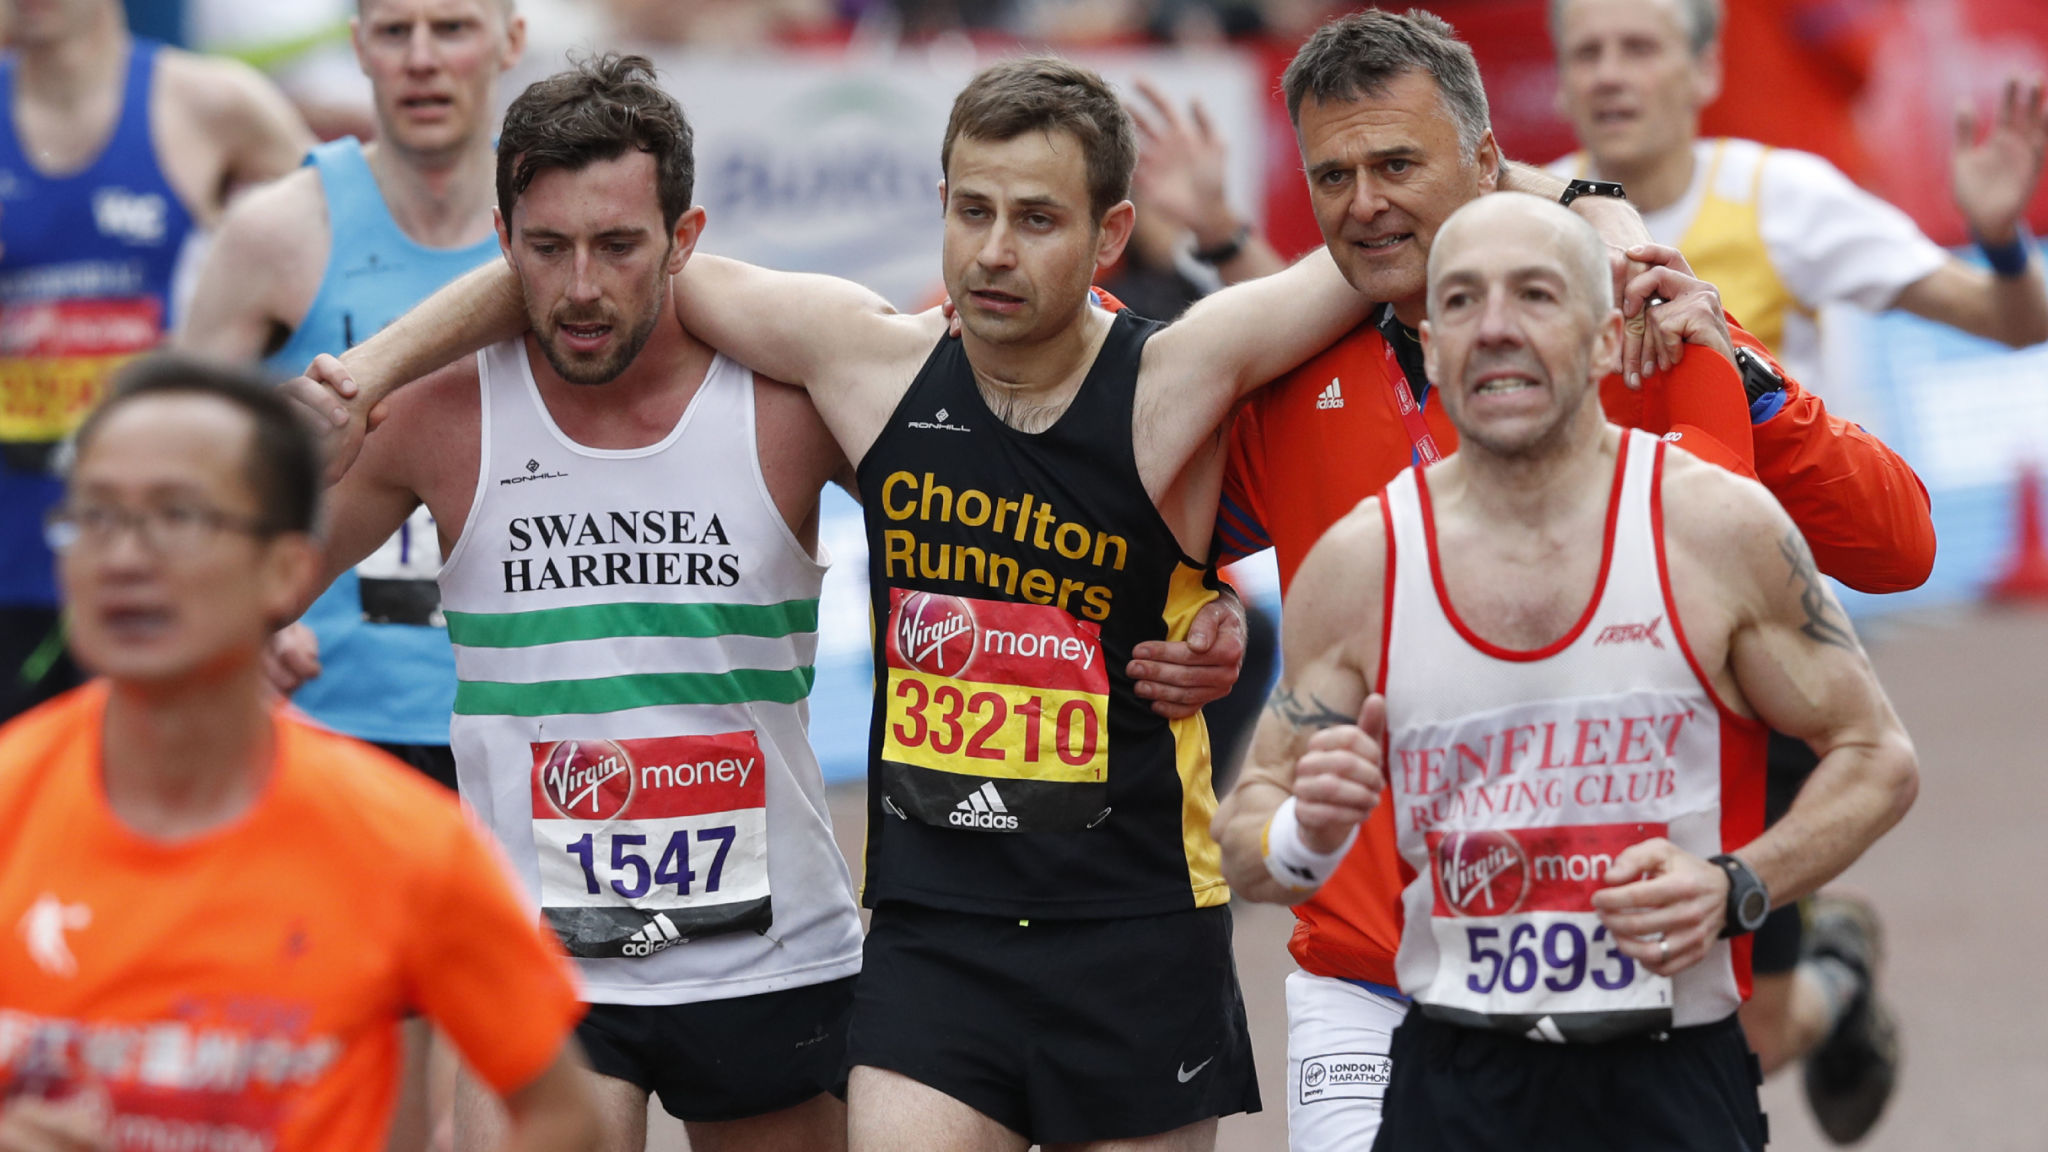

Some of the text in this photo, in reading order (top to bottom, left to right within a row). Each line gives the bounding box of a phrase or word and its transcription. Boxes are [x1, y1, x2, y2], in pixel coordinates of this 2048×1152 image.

[908, 421, 971, 432] RONHILL
[500, 471, 569, 486] RONHILL
[509, 510, 731, 552] SWANSEA
[882, 470, 1128, 571] Chorlton
[501, 552, 740, 593] HARRIERS
[884, 529, 1113, 621] Runners
[902, 594, 1095, 670] Virgin money
[892, 678, 1098, 766] 33210
[549, 742, 755, 812] Virgin money
[1094, 768, 1101, 780] 1
[1409, 768, 1676, 831] RUNNING CLUB
[949, 809, 1019, 829] adidas
[566, 826, 736, 899] 1547
[1443, 833, 1517, 910] Virgin
[622, 937, 690, 956] adidas
[1465, 922, 1635, 994] 5693
[1329, 1063, 1376, 1073] LONDON
[1329, 1073, 1390, 1083] MARATHON
